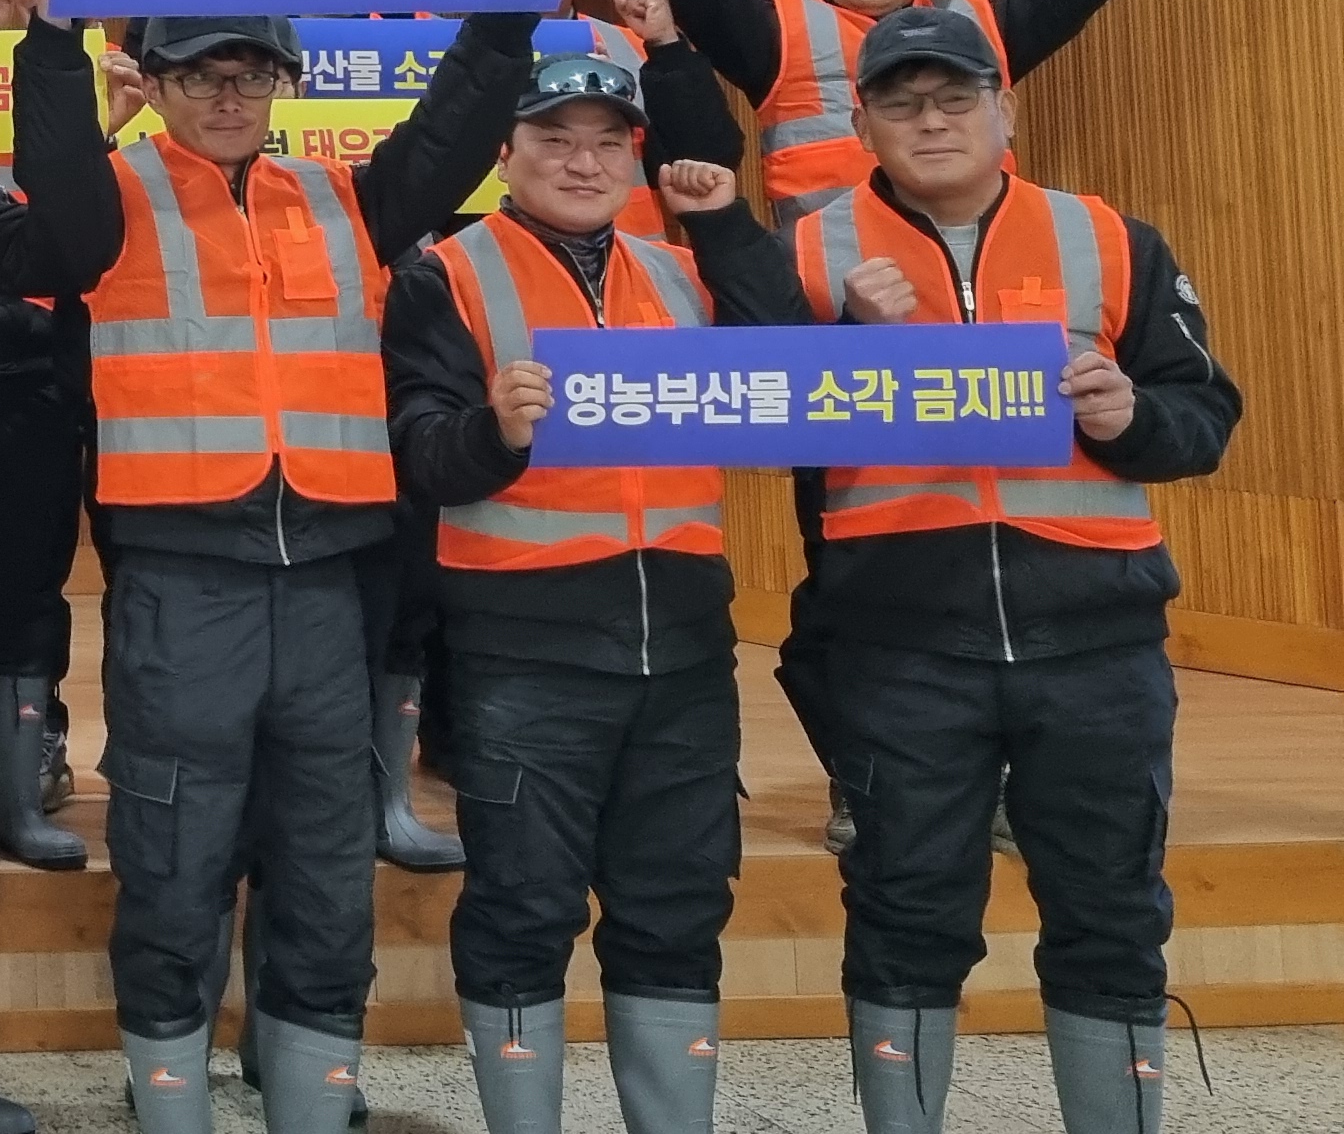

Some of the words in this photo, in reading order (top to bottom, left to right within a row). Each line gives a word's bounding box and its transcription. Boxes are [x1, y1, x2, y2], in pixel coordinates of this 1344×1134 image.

[302, 128, 394, 162] 태우
[565, 371, 791, 426] 영농부산물
[808, 369, 899, 422] 소각
[913, 367, 1045, 421] 금지!!!
